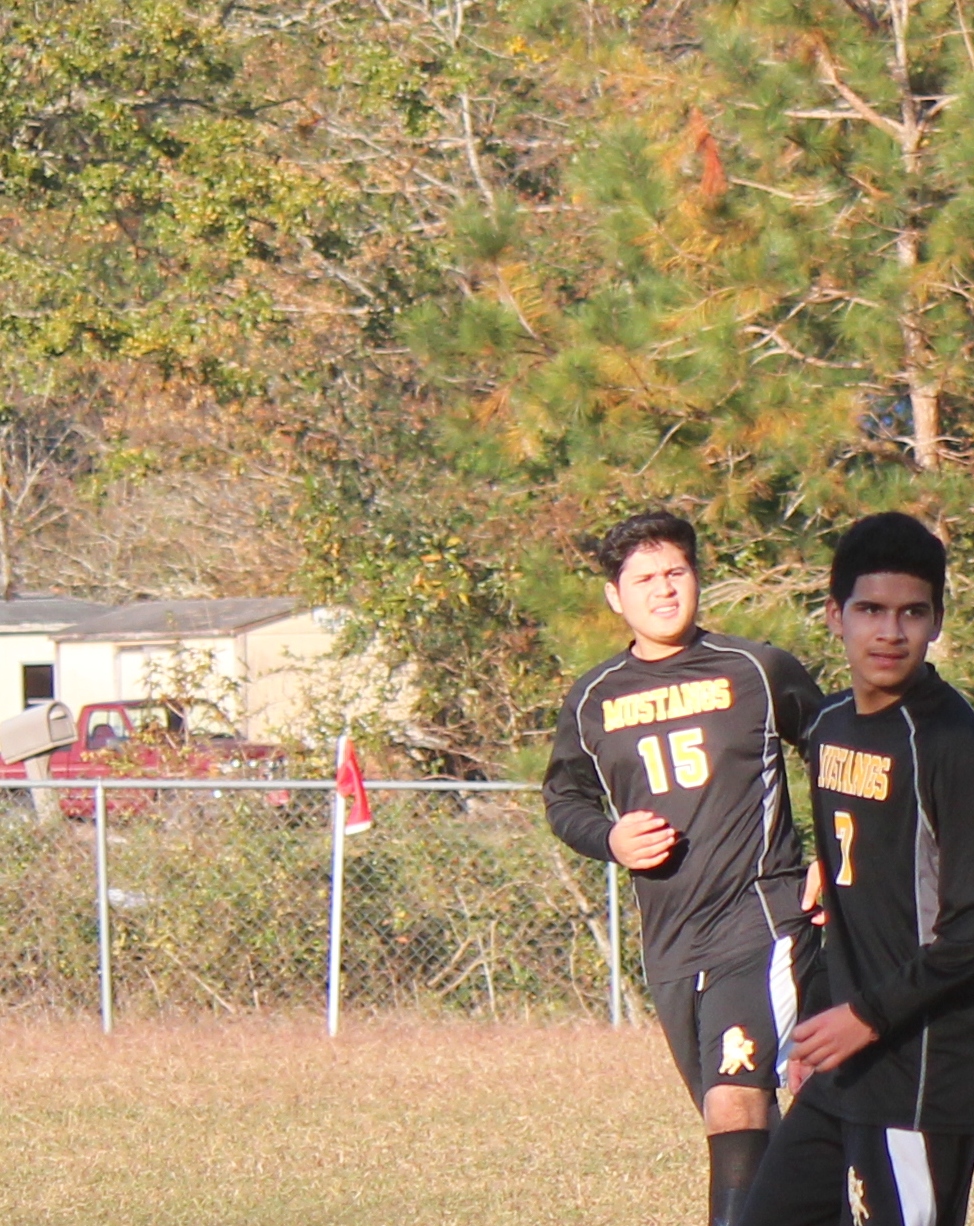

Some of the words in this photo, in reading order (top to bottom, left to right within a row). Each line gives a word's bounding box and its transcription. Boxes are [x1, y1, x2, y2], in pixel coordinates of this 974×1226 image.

[602, 678, 732, 732] MUSTANGS
[637, 727, 710, 795] 15
[834, 811, 855, 886] 7
